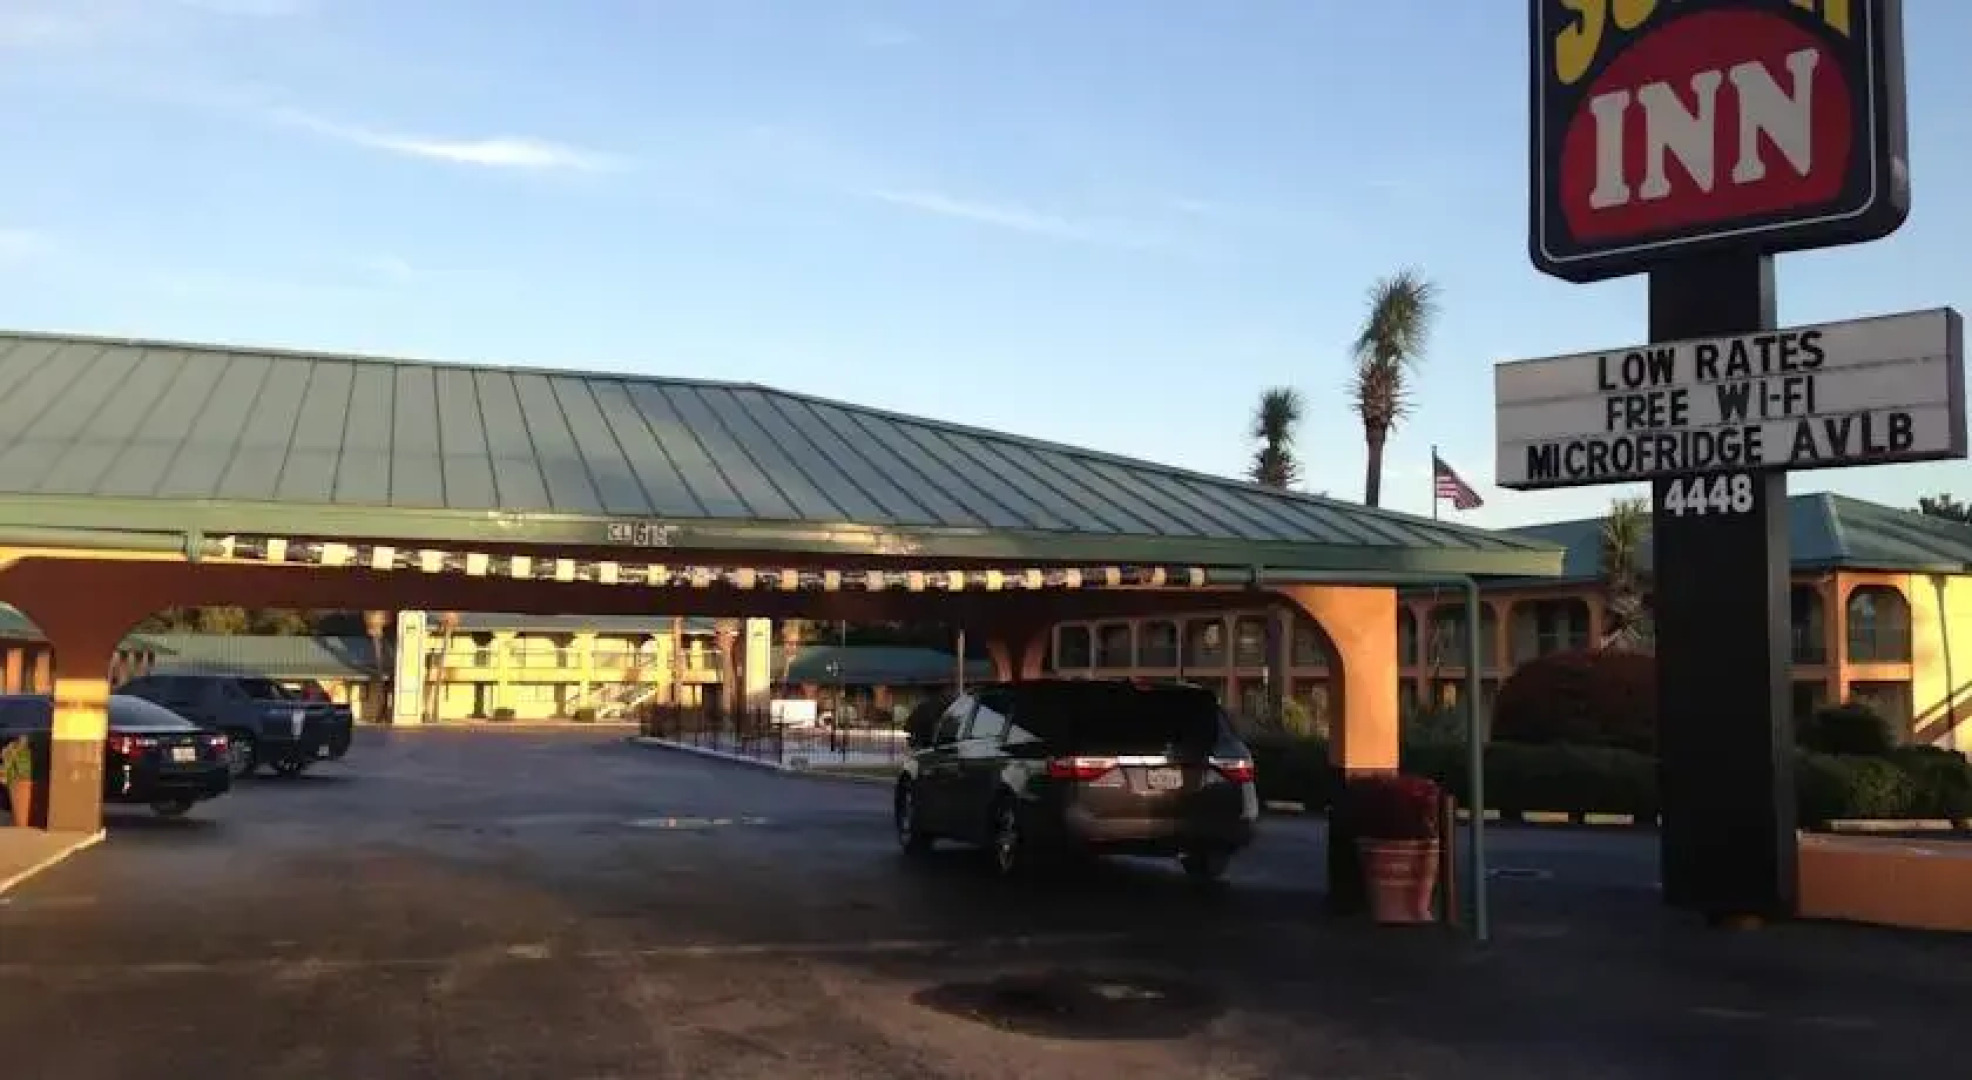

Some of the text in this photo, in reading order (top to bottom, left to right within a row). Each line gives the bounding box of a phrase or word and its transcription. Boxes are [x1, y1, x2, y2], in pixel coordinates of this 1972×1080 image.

[1590, 48, 1819, 209] INN
[1599, 330, 1824, 391] LOW RATES
[1606, 375, 1816, 431] FREE WI-FI
[1526, 412, 1914, 480] MICROFRIDGE AVLB
[1664, 475, 1754, 516] 4448
